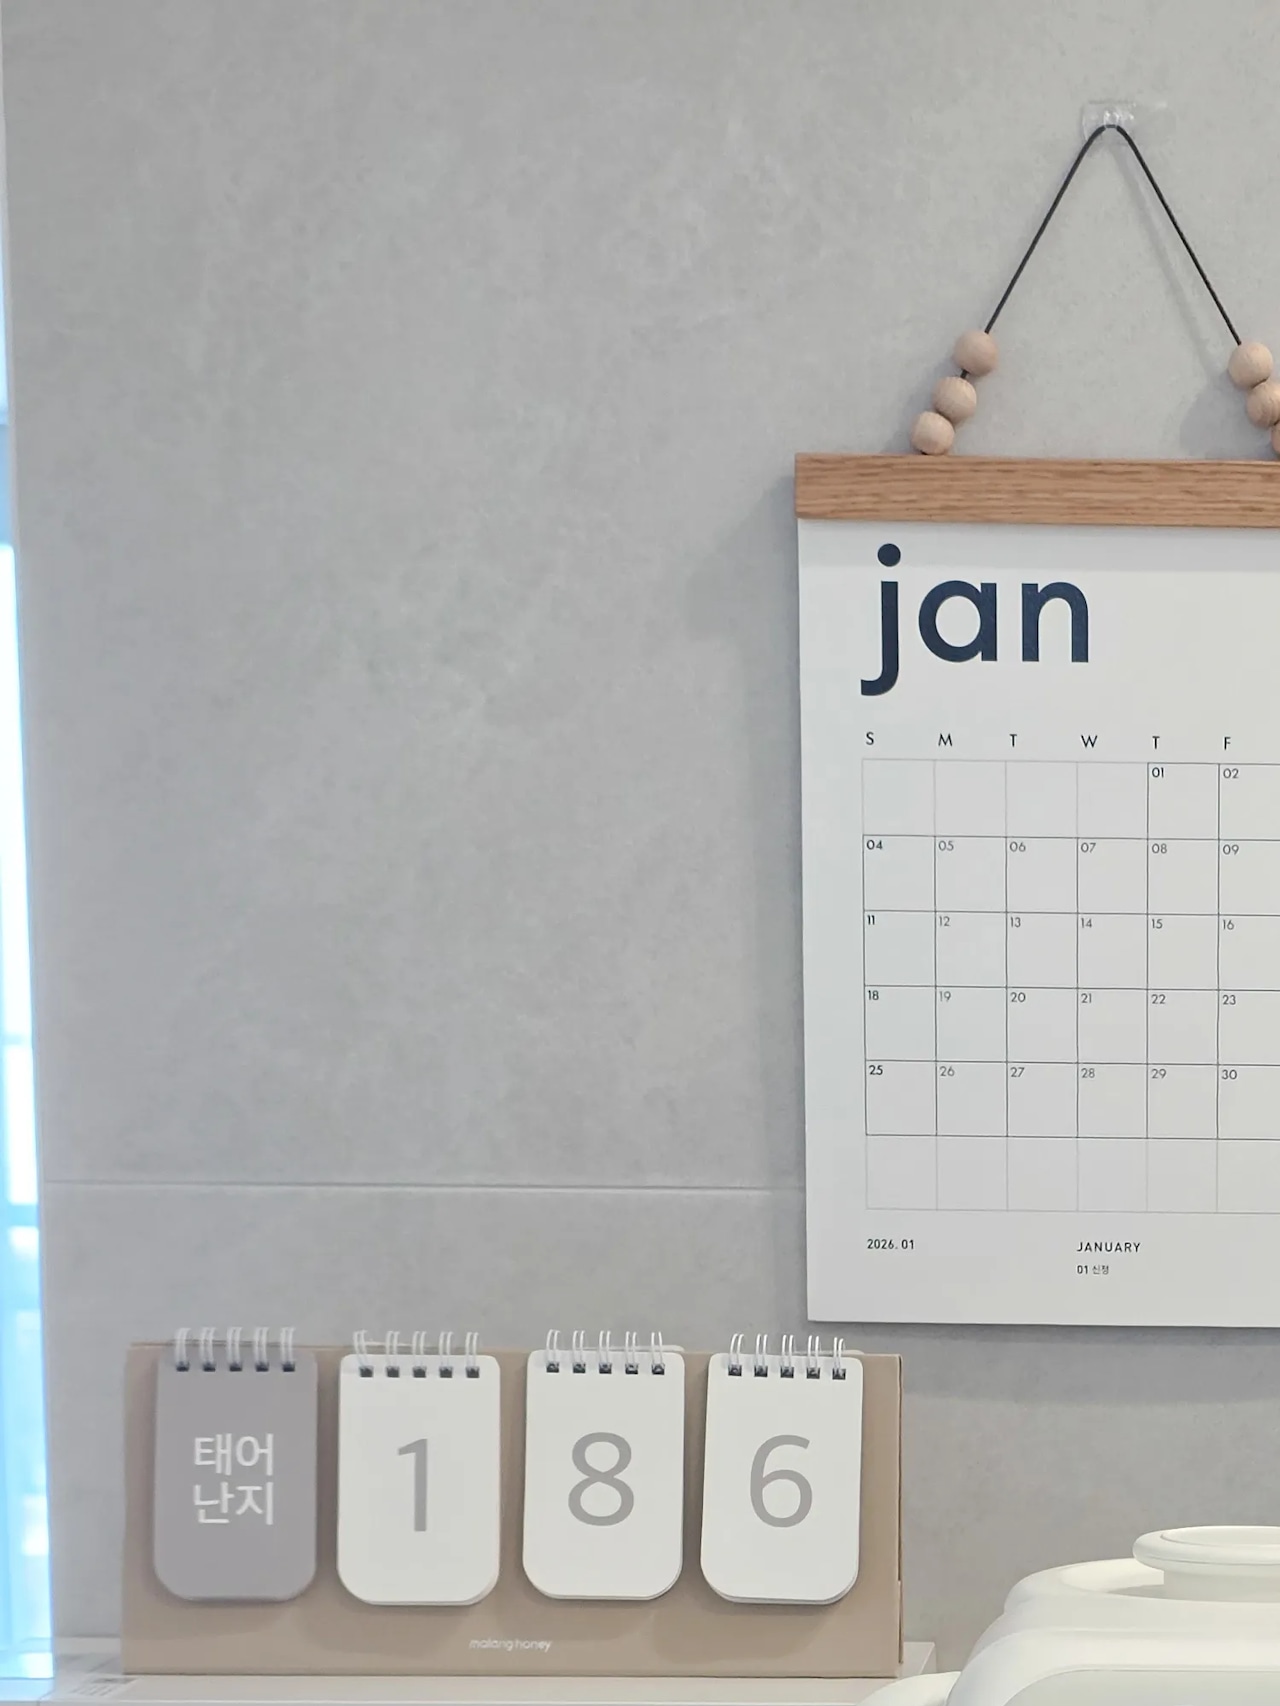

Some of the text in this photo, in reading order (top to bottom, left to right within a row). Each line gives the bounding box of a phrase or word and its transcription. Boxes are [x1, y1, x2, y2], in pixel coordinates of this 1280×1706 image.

[859, 542, 1090, 698] jan
[866, 731, 875, 746] S
[938, 733, 953, 747] M
[1009, 733, 1018, 748] T
[1080, 735, 1098, 748] W
[1152, 735, 1160, 750] T
[1224, 736, 1231, 750] F
[1151, 766, 1166, 779] 01
[1222, 767, 1239, 779] 02
[866, 839, 883, 851] 04
[938, 840, 955, 852] 05
[1009, 841, 1027, 853] 06
[1080, 841, 1097, 853] 07
[1151, 842, 1168, 854] 08
[1222, 844, 1240, 855] 09
[866, 914, 877, 926] 11
[937, 915, 951, 927] 12
[1008, 916, 1022, 928] 13
[1079, 917, 1093, 929] 14
[1150, 917, 1164, 930] 15
[1221, 918, 1235, 931] 16
[867, 989, 880, 1002] 18
[938, 990, 952, 1003] 19
[1010, 991, 1026, 1003] 20
[1080, 992, 1092, 1004] 21
[1151, 993, 1166, 1005] 22
[1222, 994, 1237, 1006] 23
[868, 1064, 884, 1076] 25
[939, 1065, 955, 1077] 26
[1010, 1066, 1025, 1078] 27
[1080, 1067, 1096, 1079] 28
[1151, 1068, 1167, 1079] 29
[1221, 1069, 1238, 1080] 30
[1077, 1241, 1140, 1253] JANUARY
[1077, 1264, 1088, 1275] 01
[194, 1433, 274, 1476] 태어
[396, 1430, 814, 1533] 1 8 6
[194, 1481, 274, 1526] 난지
